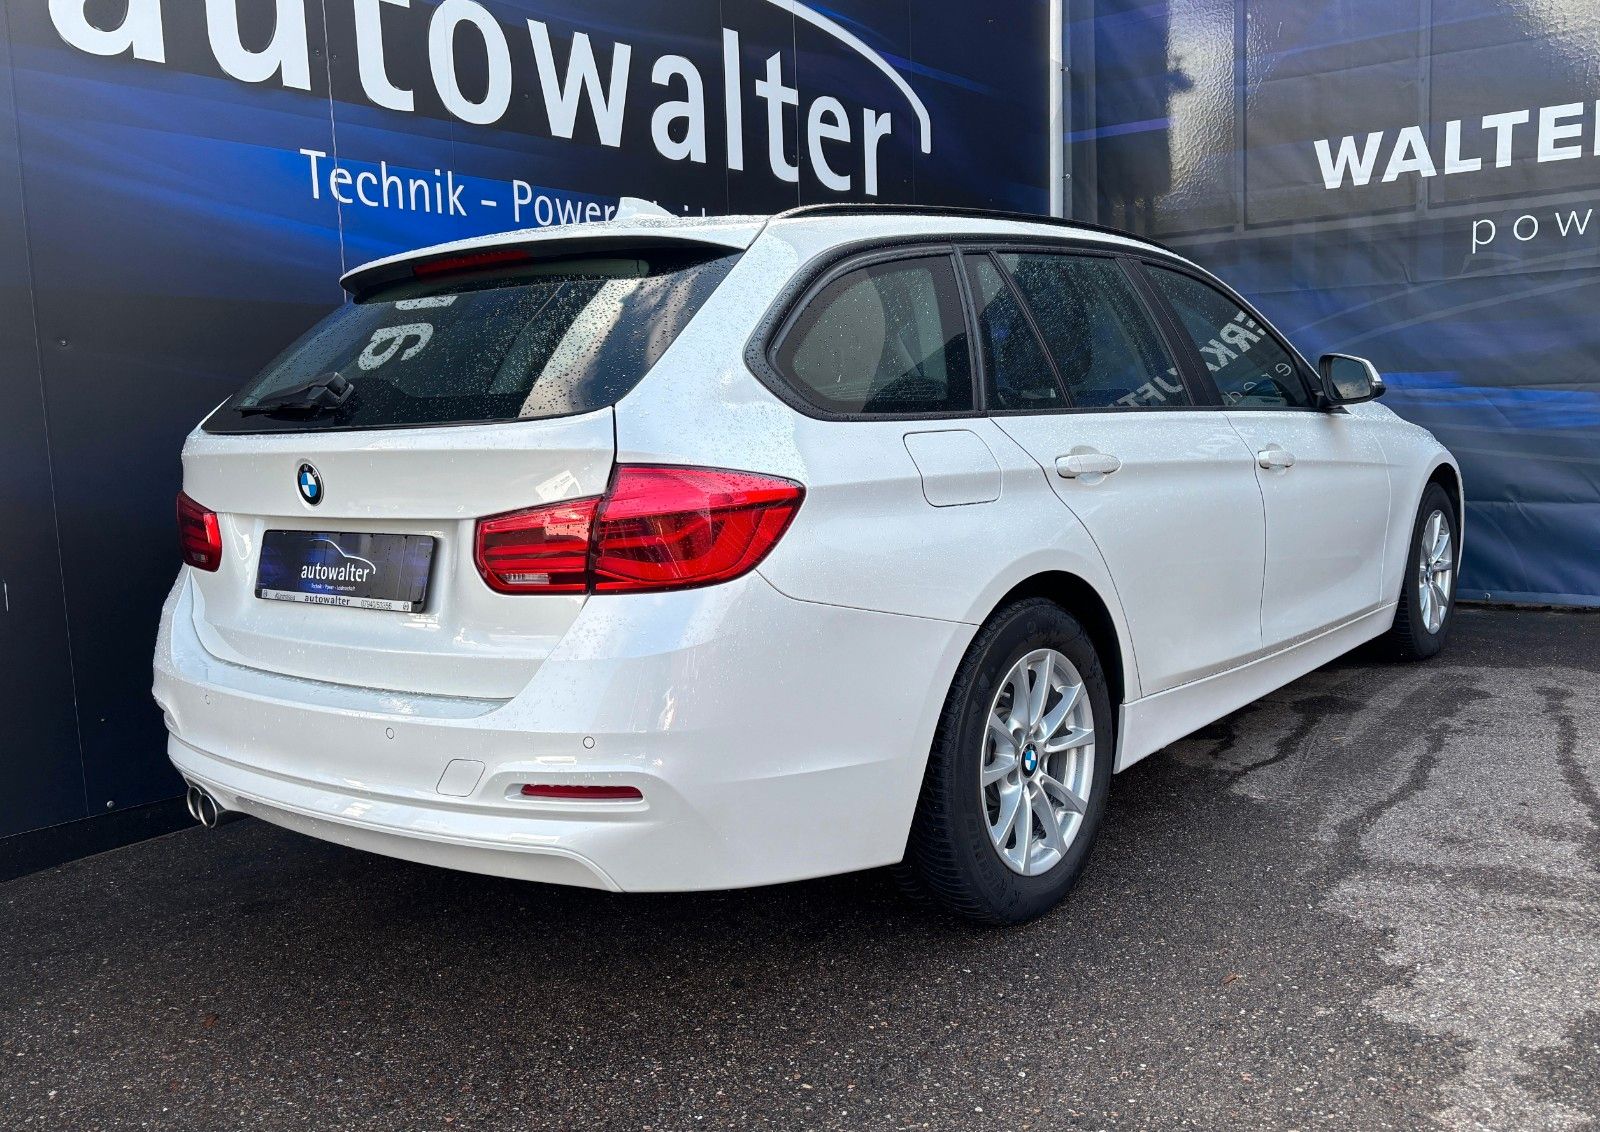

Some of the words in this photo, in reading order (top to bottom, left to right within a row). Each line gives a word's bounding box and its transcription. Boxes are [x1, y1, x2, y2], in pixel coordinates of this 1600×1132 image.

[1313, 99, 1600, 190] WALTE
[299, 148, 468, 217] Technik
[512, 179, 616, 226] Power
[301, 562, 369, 582] autowalter
[304, 594, 350, 606] autowalter
